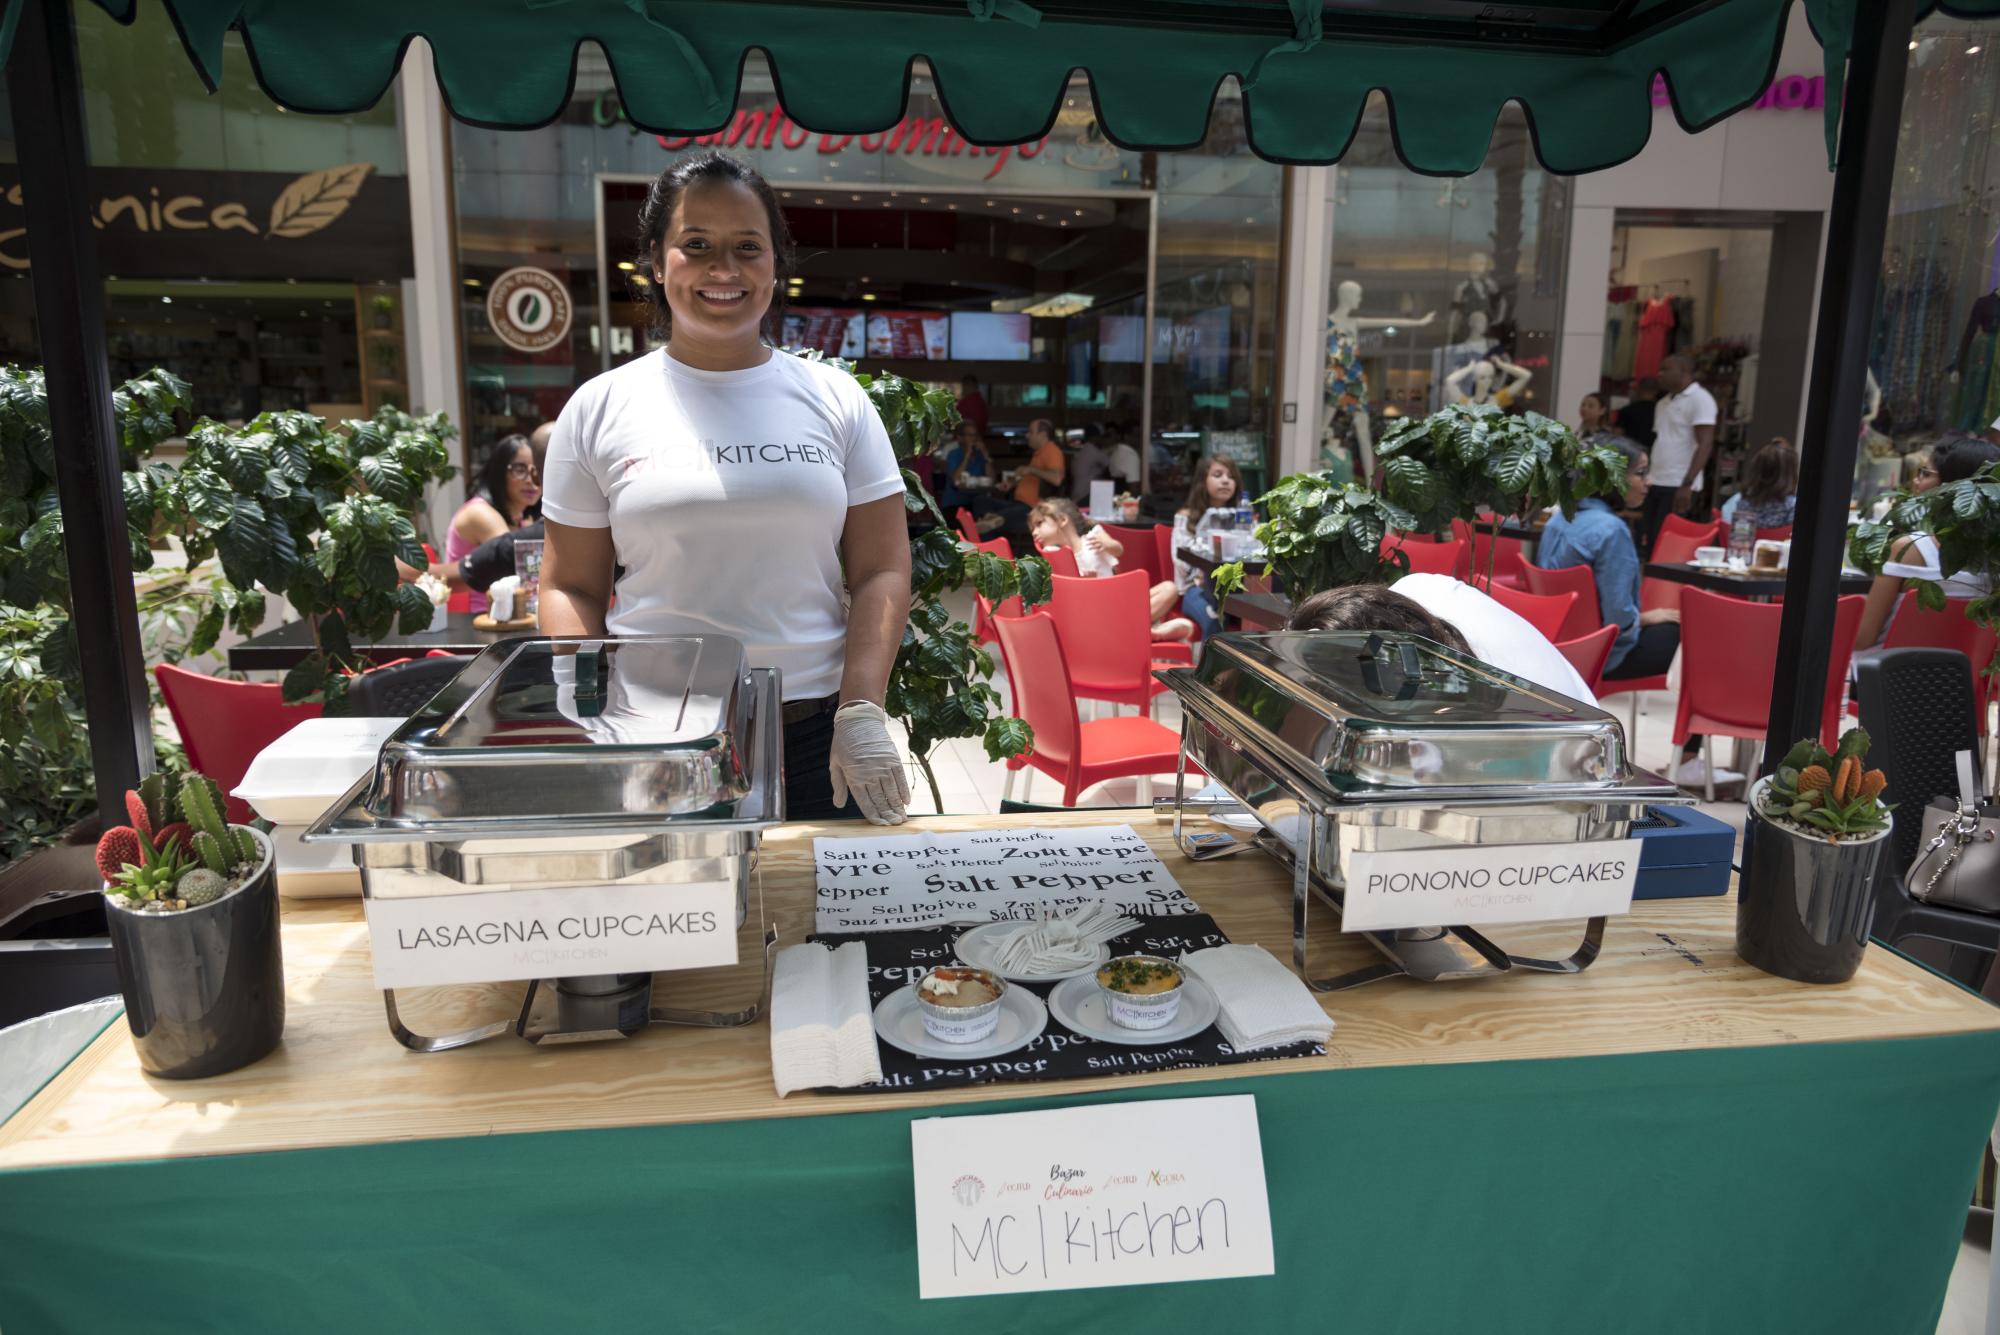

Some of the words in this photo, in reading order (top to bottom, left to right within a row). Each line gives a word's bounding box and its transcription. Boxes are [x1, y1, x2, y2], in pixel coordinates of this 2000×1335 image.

[823, 850, 868, 861] Salt
[877, 846, 961, 860] Pepper
[1000, 847, 1071, 859] Zout
[924, 873, 1000, 894] Salt
[1008, 868, 1155, 891] Pepper
[1367, 868, 1491, 894] PIONONO
[1497, 860, 1626, 887] CUPCAKES
[872, 903, 904, 916] Sel
[912, 899, 977, 914] Poivre
[988, 908, 1019, 921] Salt
[397, 918, 550, 951] LASAGNA
[557, 910, 718, 941] CUPCAKES
[910, 942, 950, 959] Sel
[1087, 1054, 1124, 1069] Salt
[1131, 1047, 1195, 1067] Pepper
[922, 1057, 1048, 1082] Pepper
[1049, 1164, 1087, 1182] Bazar
[1043, 1182, 1094, 1201] Culinario
